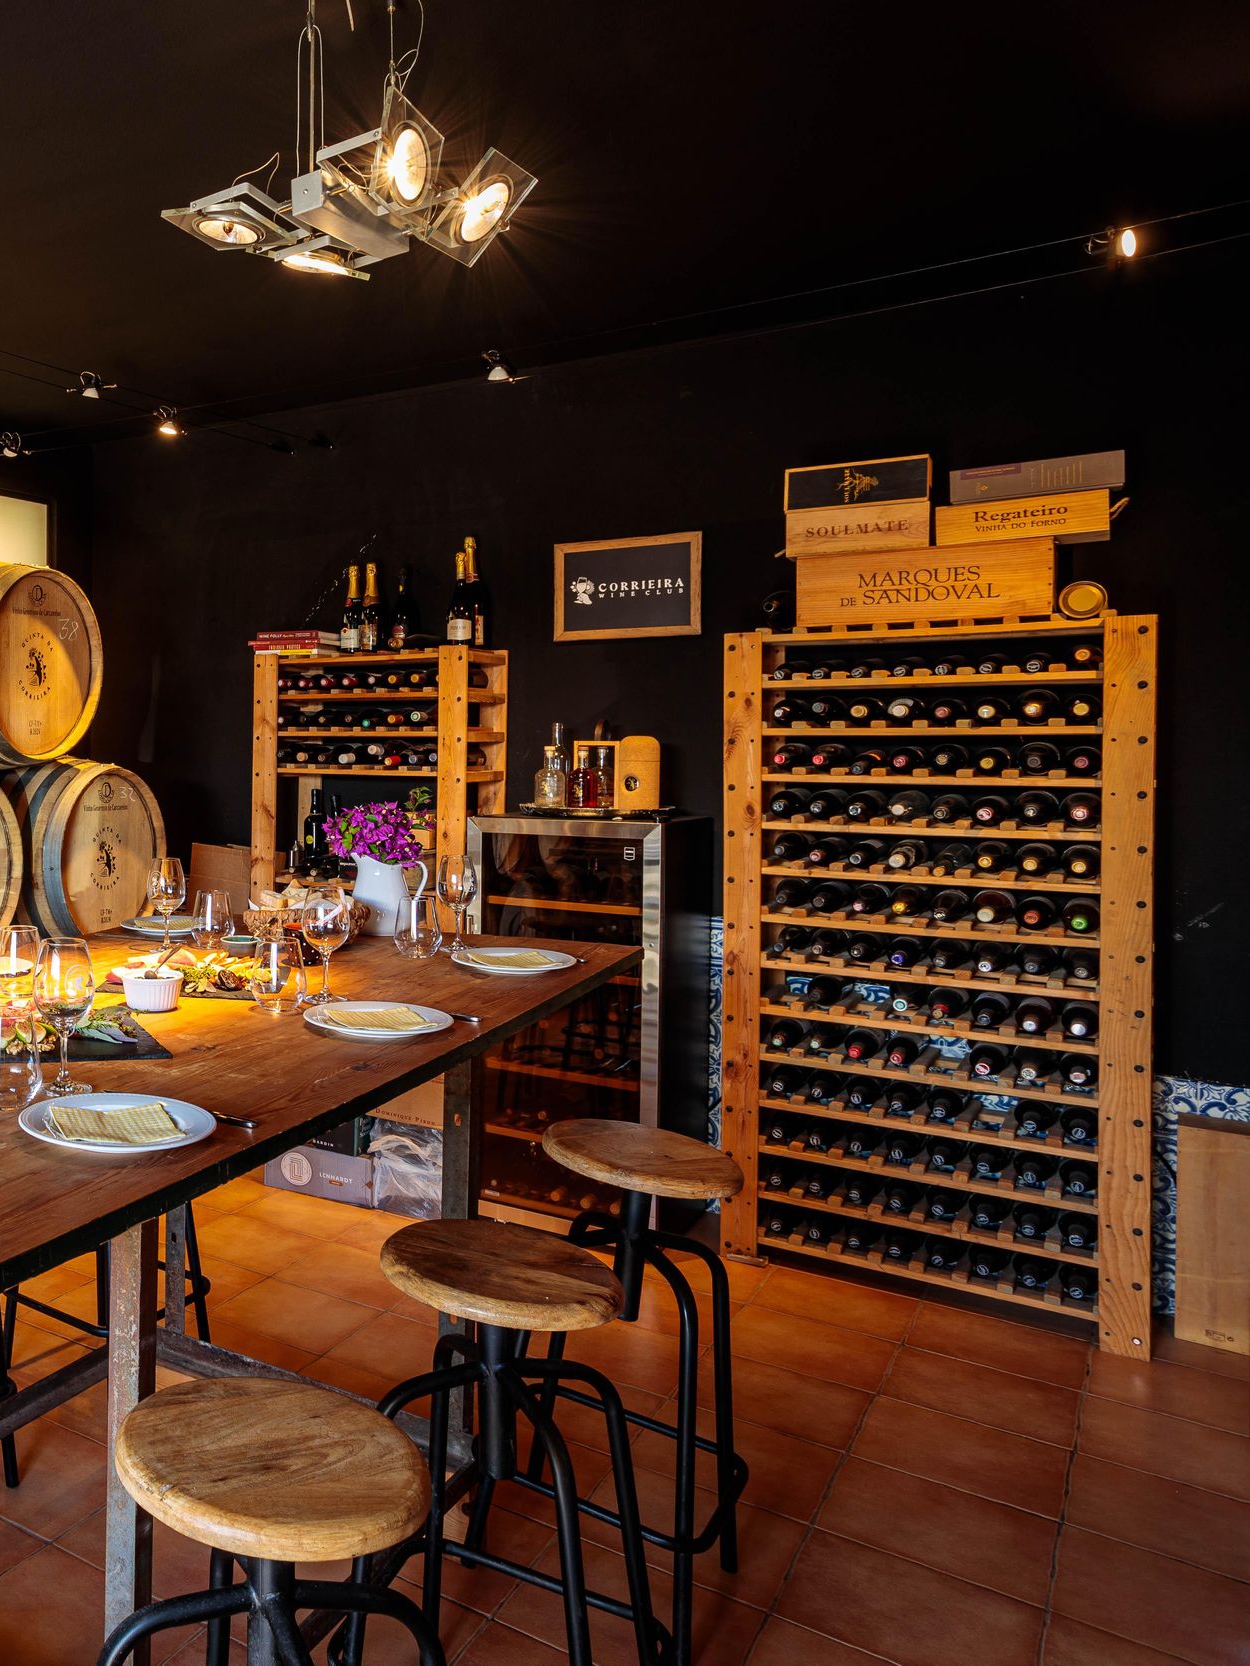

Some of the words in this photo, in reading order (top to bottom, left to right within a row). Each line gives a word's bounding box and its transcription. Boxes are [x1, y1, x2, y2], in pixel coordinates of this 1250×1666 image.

[973, 505, 1068, 523] Regateiro
[805, 519, 910, 538] SOULMATE
[975, 524, 1007, 532] VINHA
[1030, 518, 1067, 527] FORNO
[598, 577, 685, 593] CORRIEIRA
[858, 565, 980, 588] MARQUES
[599, 590, 636, 599] WINE
[645, 588, 684, 596] CLUB
[840, 597, 857, 607] DE
[862, 583, 1000, 605] SANDOVAL
[59, 618, 78, 641] 38
[21, 632, 44, 648] QUINTA
[18, 679, 51, 701] CORRIEIRA
[119, 786, 135, 802] 32
[92, 826, 114, 843] QUINTA
[89, 873, 120, 891] CORRIEIRA
